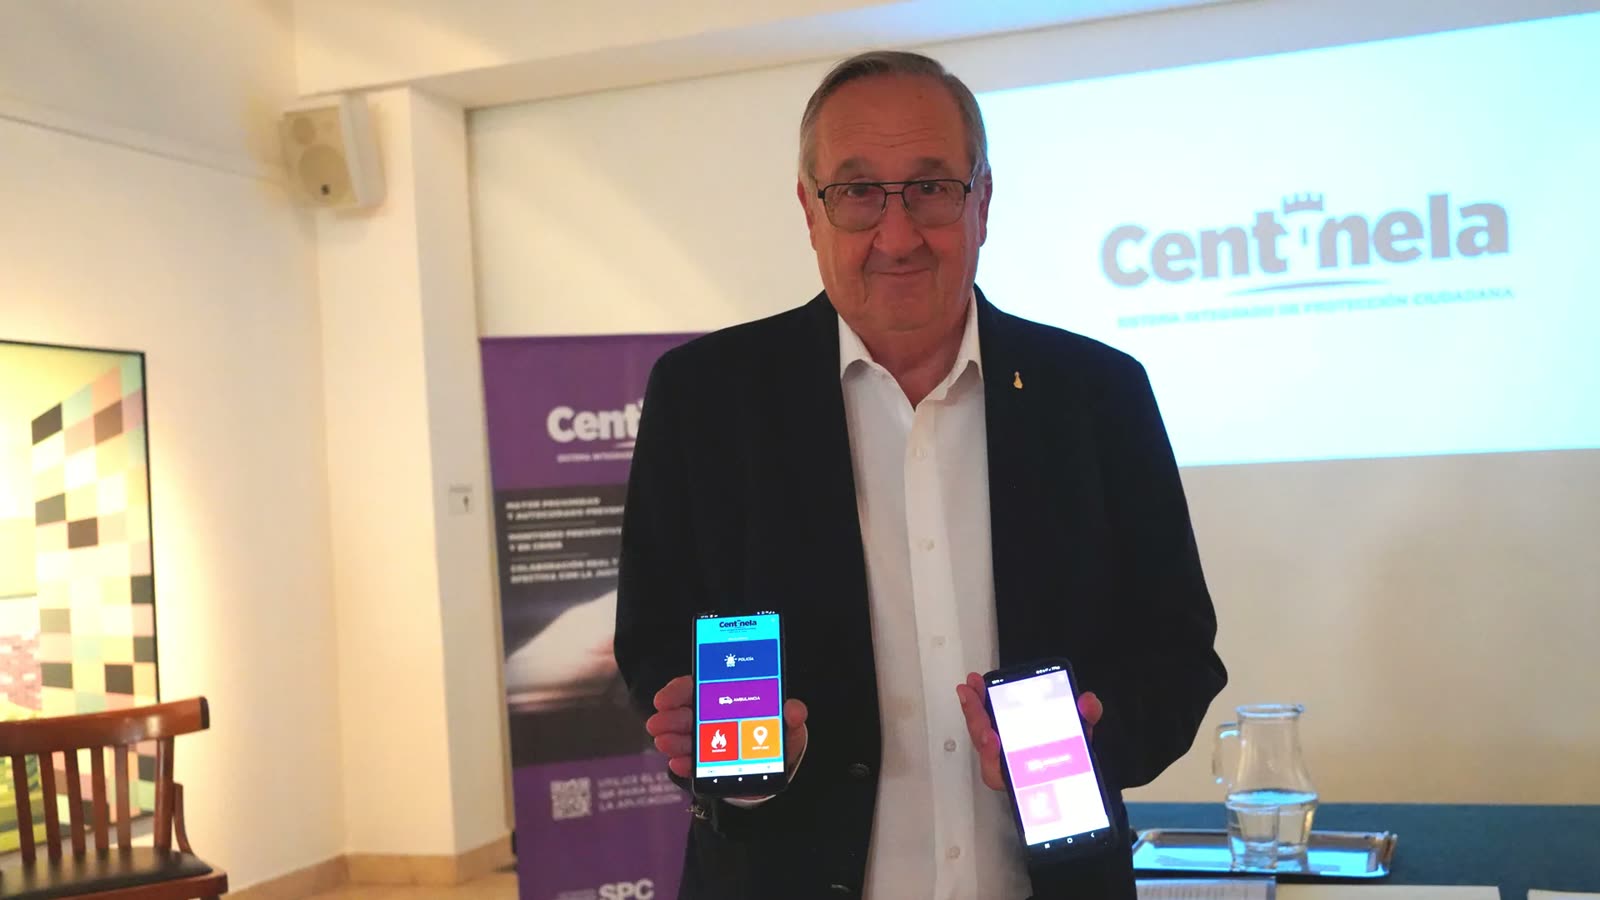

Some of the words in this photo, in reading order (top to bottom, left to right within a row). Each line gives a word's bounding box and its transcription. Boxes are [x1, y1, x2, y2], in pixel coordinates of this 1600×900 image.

[1101, 192, 1510, 288] Centinela
[547, 399, 643, 443] Cent
[719, 619, 758, 629] Centinela
[599, 877, 655, 900] SPC
